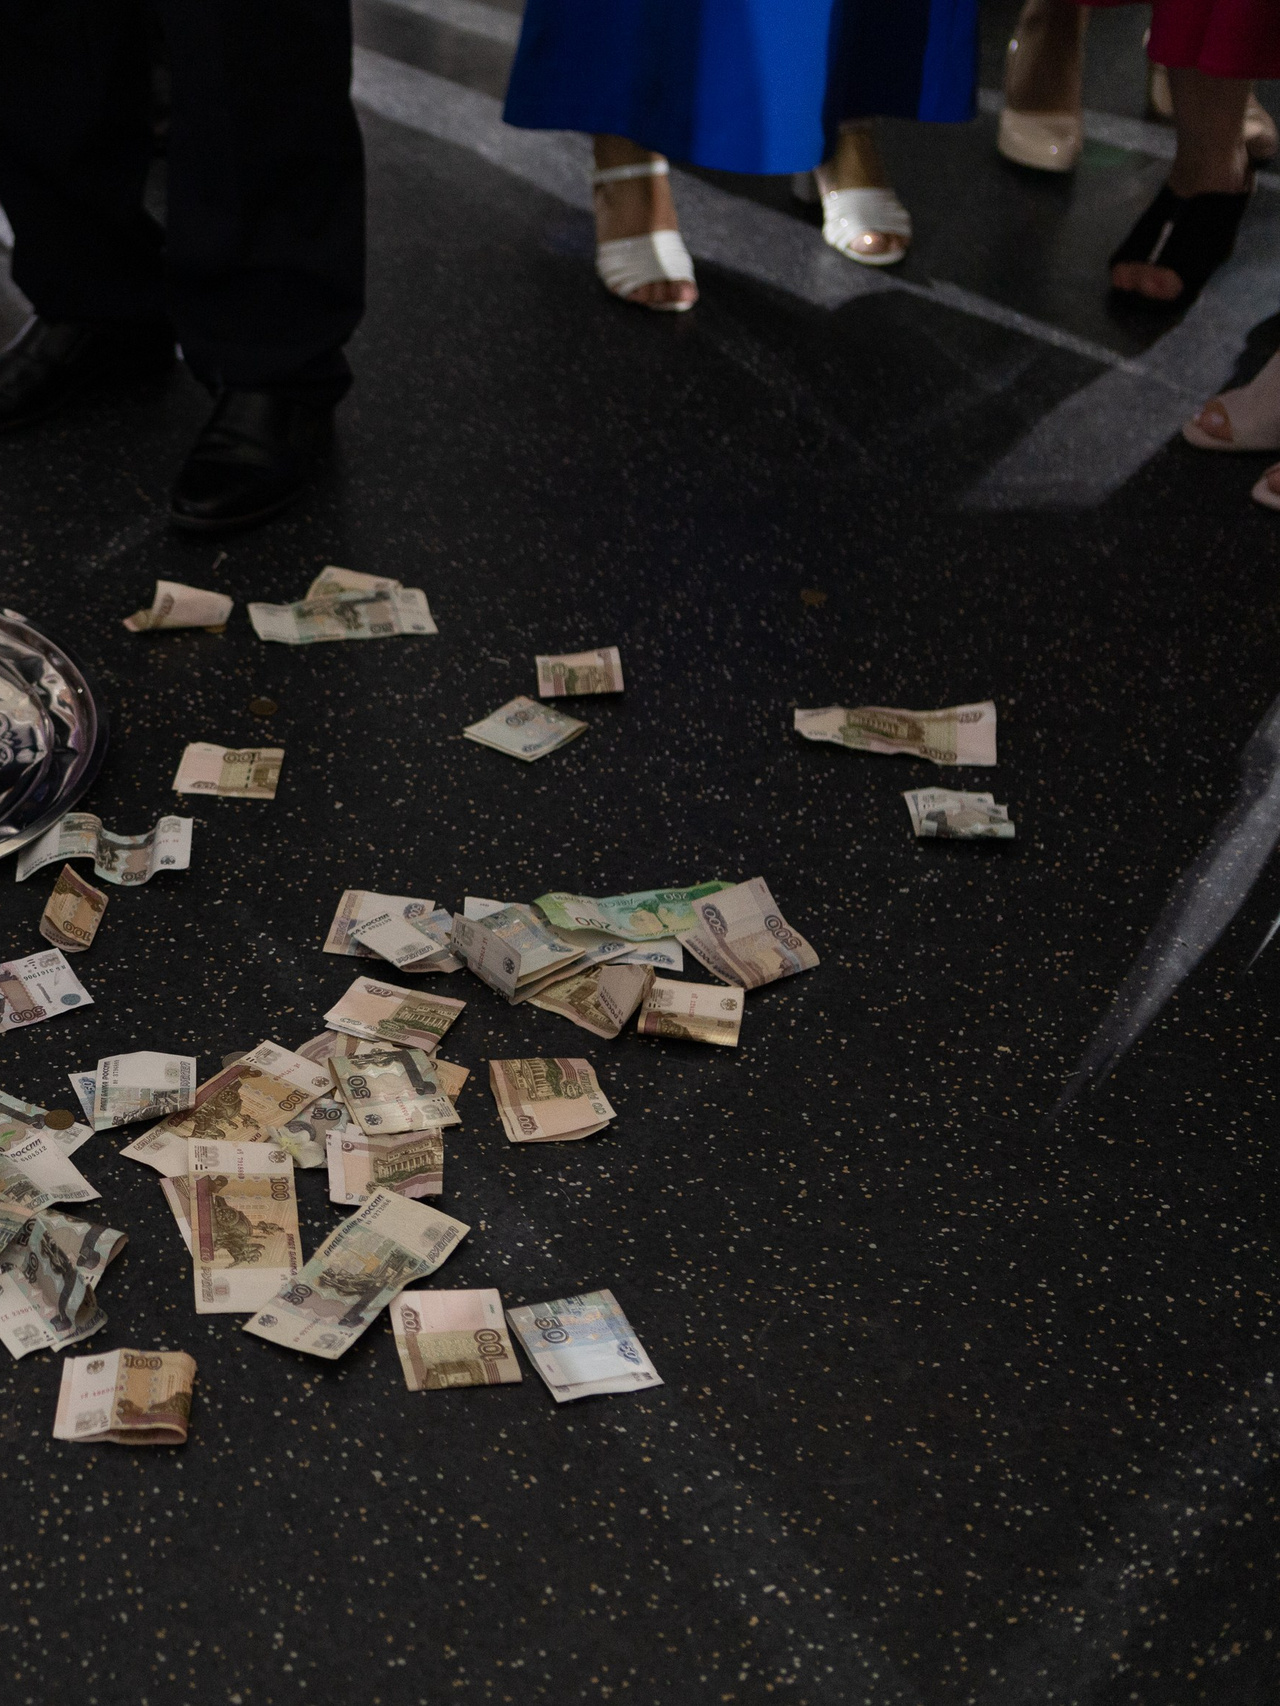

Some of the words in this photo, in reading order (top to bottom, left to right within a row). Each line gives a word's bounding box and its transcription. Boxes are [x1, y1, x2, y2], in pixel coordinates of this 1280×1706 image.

[63, 920, 92, 942] 100
[764, 914, 803, 951] 500
[9, 1005, 47, 1023] 500
[347, 1075, 371, 1099] 50
[279, 1088, 309, 1112] 100
[310, 1107, 343, 1121] 50
[269, 1176, 291, 1202] 100
[360, 1193, 385, 1219] РОССИИ
[283, 1284, 313, 1307] 50
[402, 1310, 419, 1333] 100
[534, 1315, 570, 1344] 50
[473, 1328, 509, 1365] 100
[123, 1354, 164, 1371] 100
